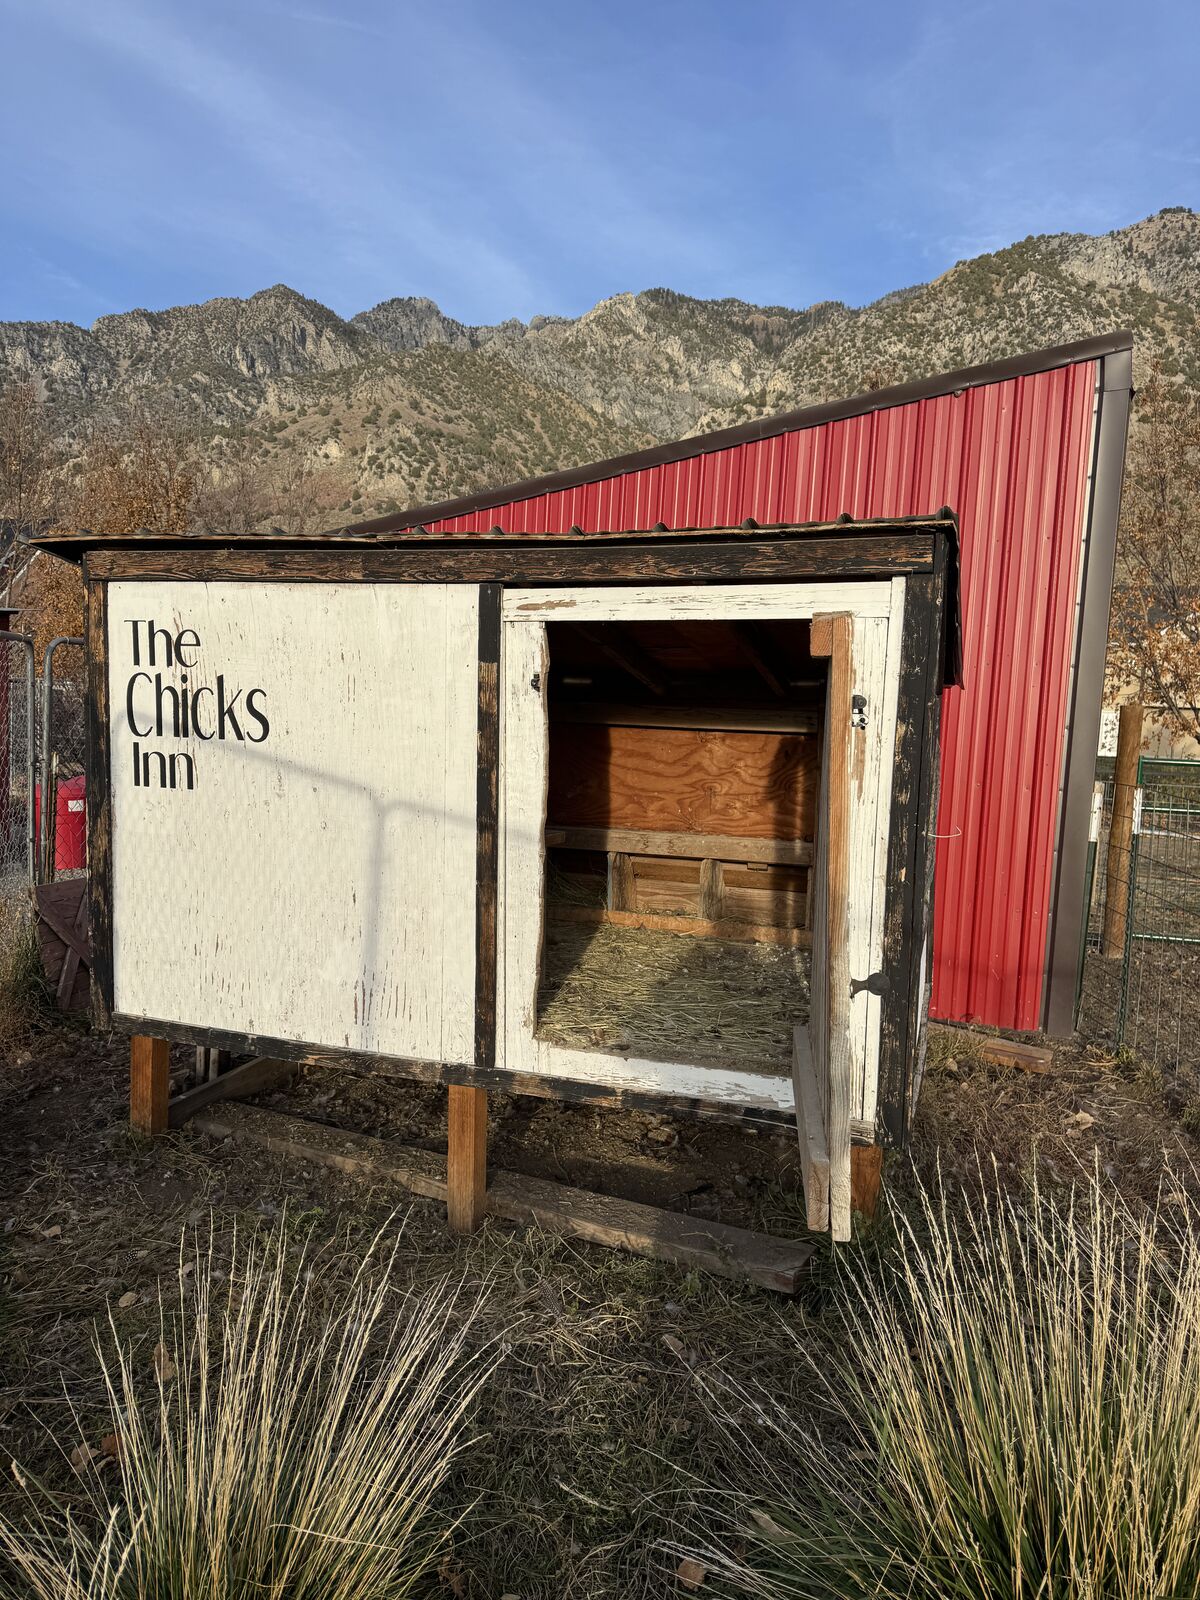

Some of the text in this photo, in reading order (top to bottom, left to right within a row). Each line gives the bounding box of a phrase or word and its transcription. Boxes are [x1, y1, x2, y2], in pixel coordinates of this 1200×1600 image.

[124, 620, 201, 668] The
[126, 672, 270, 743] Chicks
[133, 742, 194, 790] Inn
